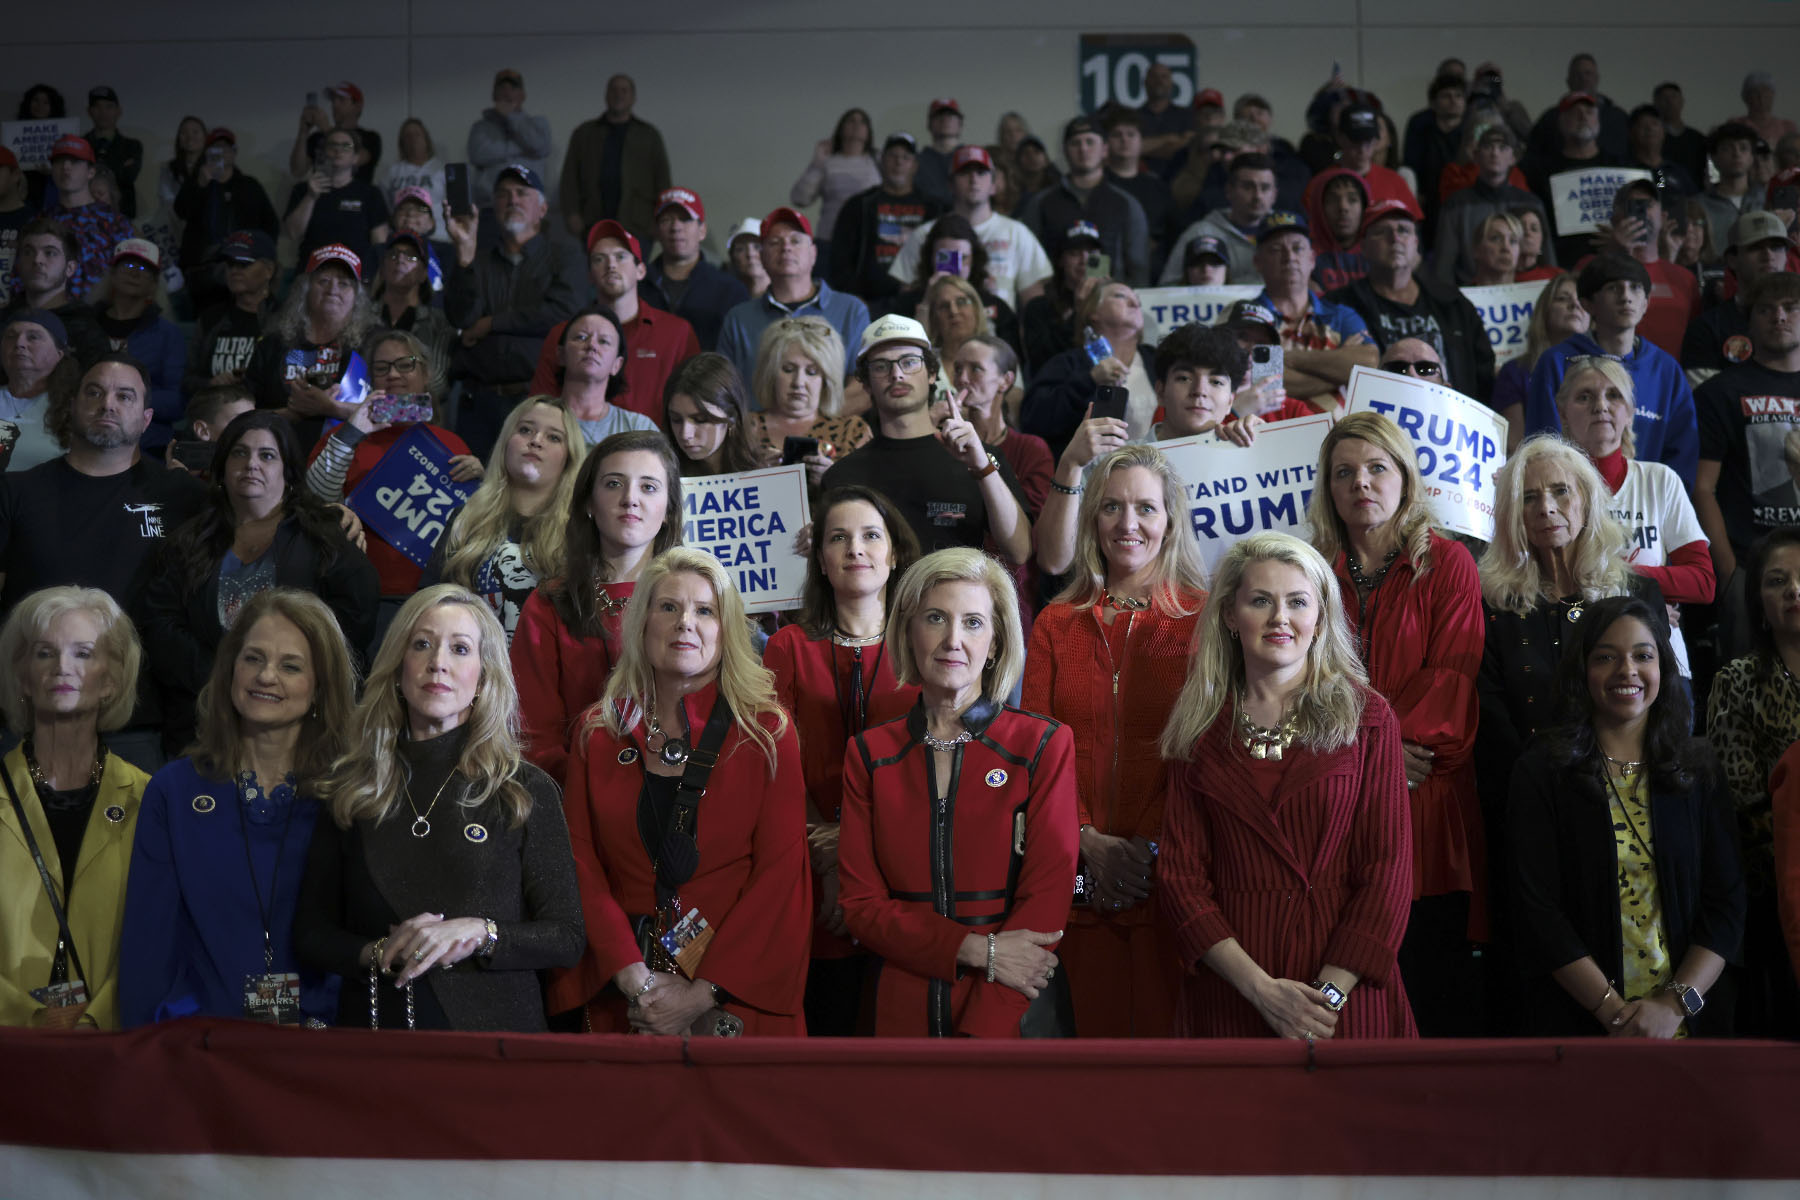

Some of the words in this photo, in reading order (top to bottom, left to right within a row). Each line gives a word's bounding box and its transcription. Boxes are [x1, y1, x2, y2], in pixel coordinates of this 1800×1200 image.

[1083, 53, 1193, 109] 105
[23, 124, 58, 134] MAKE
[13, 133, 67, 145] AMERIC
[20, 144, 53, 154] GREA
[1580, 176, 1625, 185] MAKE
[1568, 187, 1620, 200] AMER
[1580, 200, 1613, 210] GRE
[1581, 210, 1614, 223] AGA
[1151, 304, 1224, 323] TRU
[1486, 325, 1528, 345] 02
[215, 336, 256, 355] ULTRA
[408, 445, 440, 476] 88022
[1415, 446, 1482, 492] 024
[407, 473, 455, 521] 24
[682, 486, 761, 515] MAKE
[376, 486, 446, 549] UMP
[1191, 488, 1313, 541] RUM
[1609, 510, 1631, 520] I'M
[1635, 511, 1644, 521] A
[140, 520, 167, 538] LINE
[682, 511, 787, 542] MERICA
[698, 540, 772, 567] EAT
[739, 567, 778, 593] IN!
[1076, 875, 1084, 894] 3:59
[249, 997, 295, 1007] REMARKS
